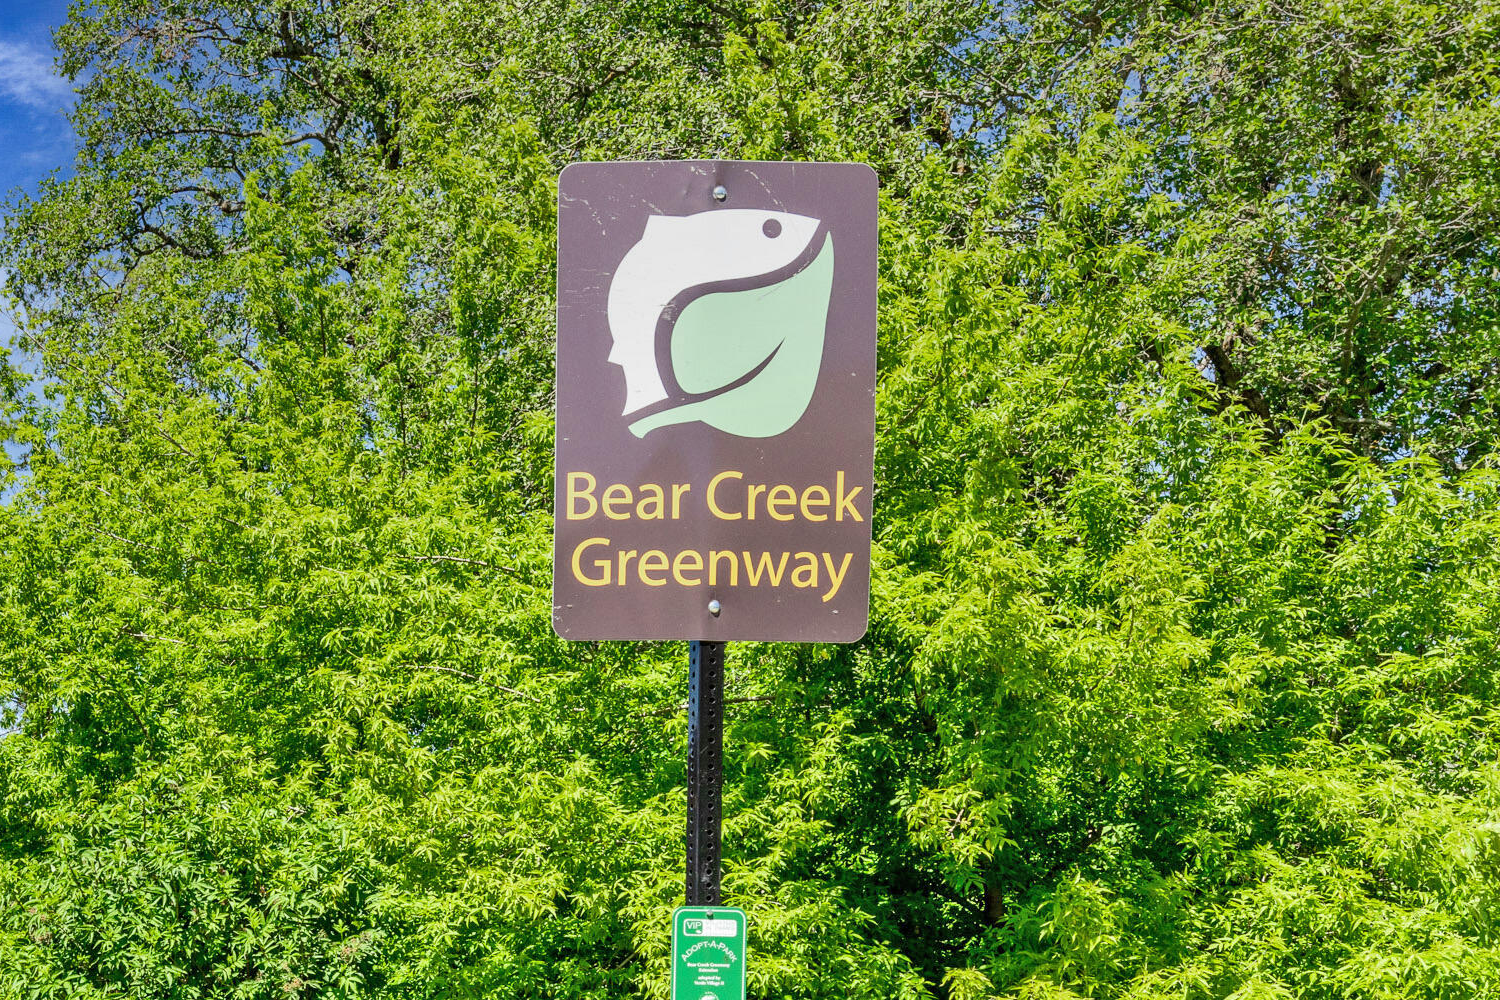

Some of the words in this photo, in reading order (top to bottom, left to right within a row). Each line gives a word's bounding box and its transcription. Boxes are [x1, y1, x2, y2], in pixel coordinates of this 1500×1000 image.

[565, 471, 690, 521] Bear
[705, 470, 864, 522] Creek
[570, 537, 854, 603] Greenway
[686, 921, 702, 929] VIP
